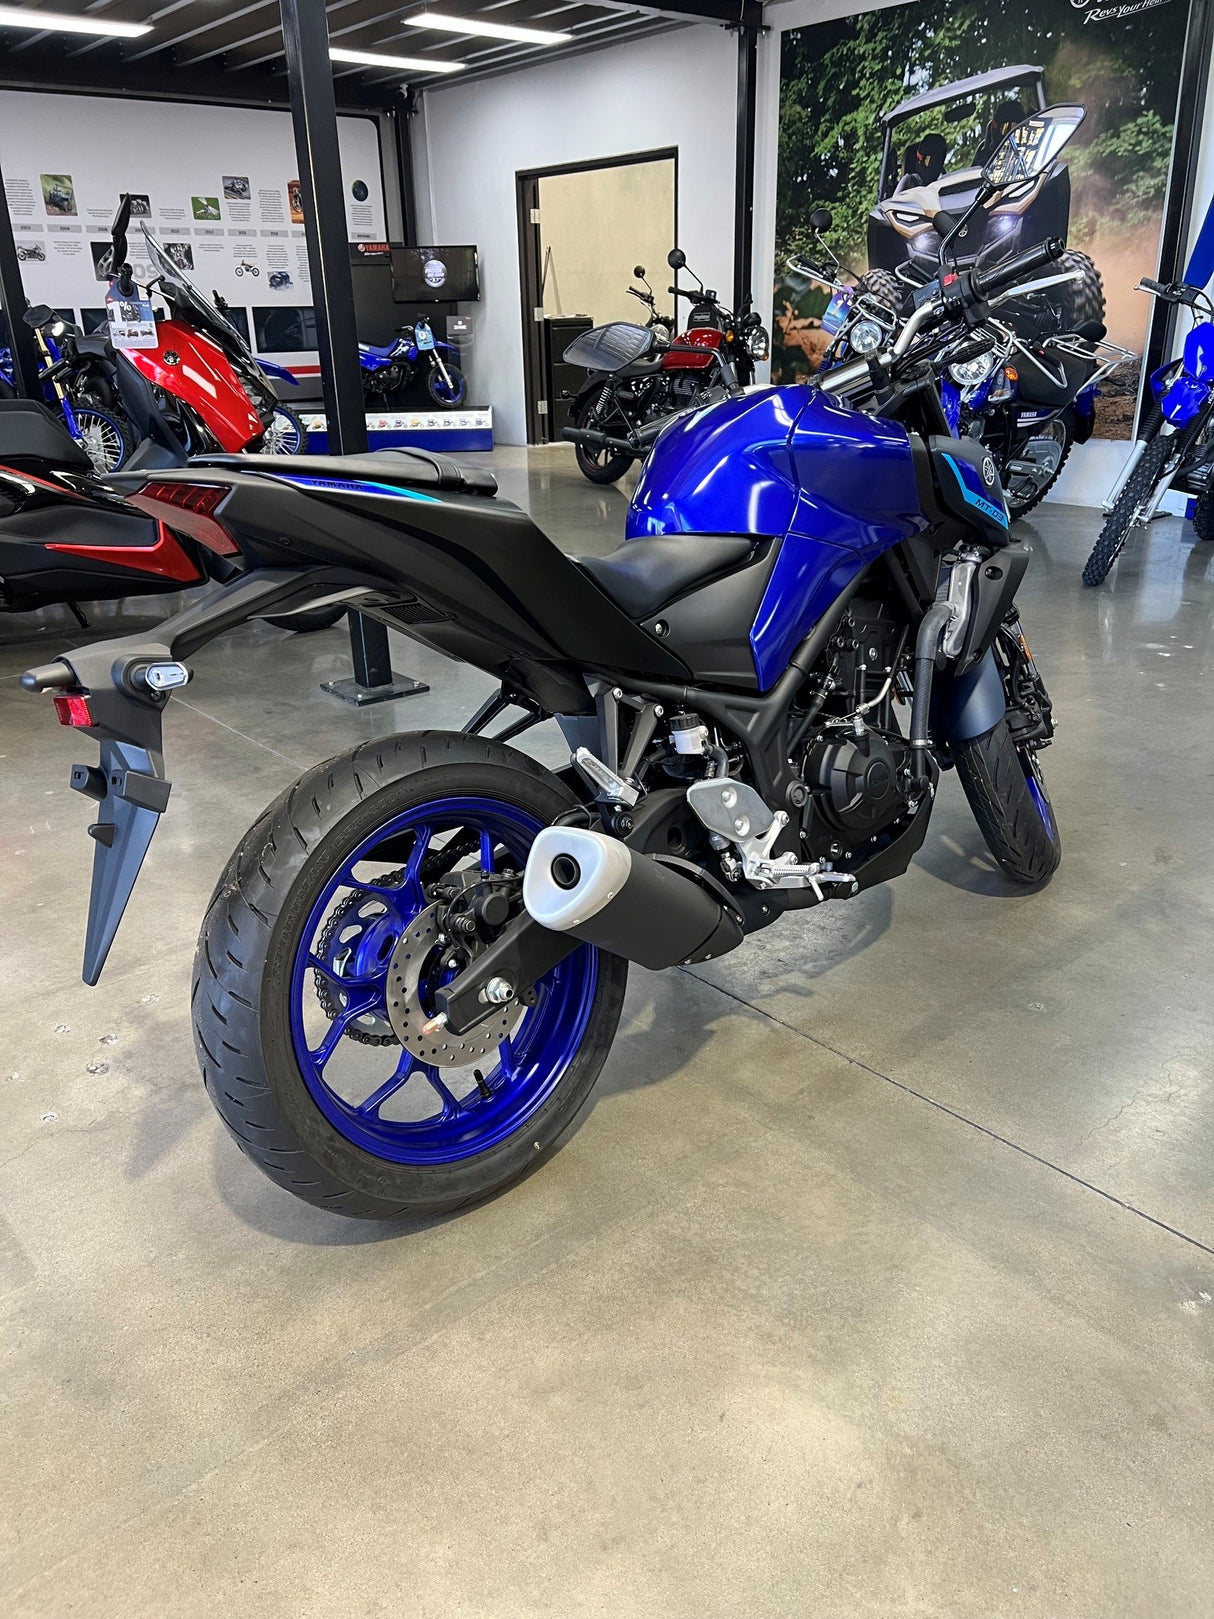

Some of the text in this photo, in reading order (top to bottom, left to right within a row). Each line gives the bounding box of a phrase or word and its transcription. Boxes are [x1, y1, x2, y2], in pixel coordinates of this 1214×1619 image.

[1083, 6, 1118, 24] Revs
[1116, 3, 1142, 18] Your
[365, 244, 390, 252] YAMAHA
[311, 479, 364, 490] YAMAHA
[975, 499, 1004, 521] MT-03
